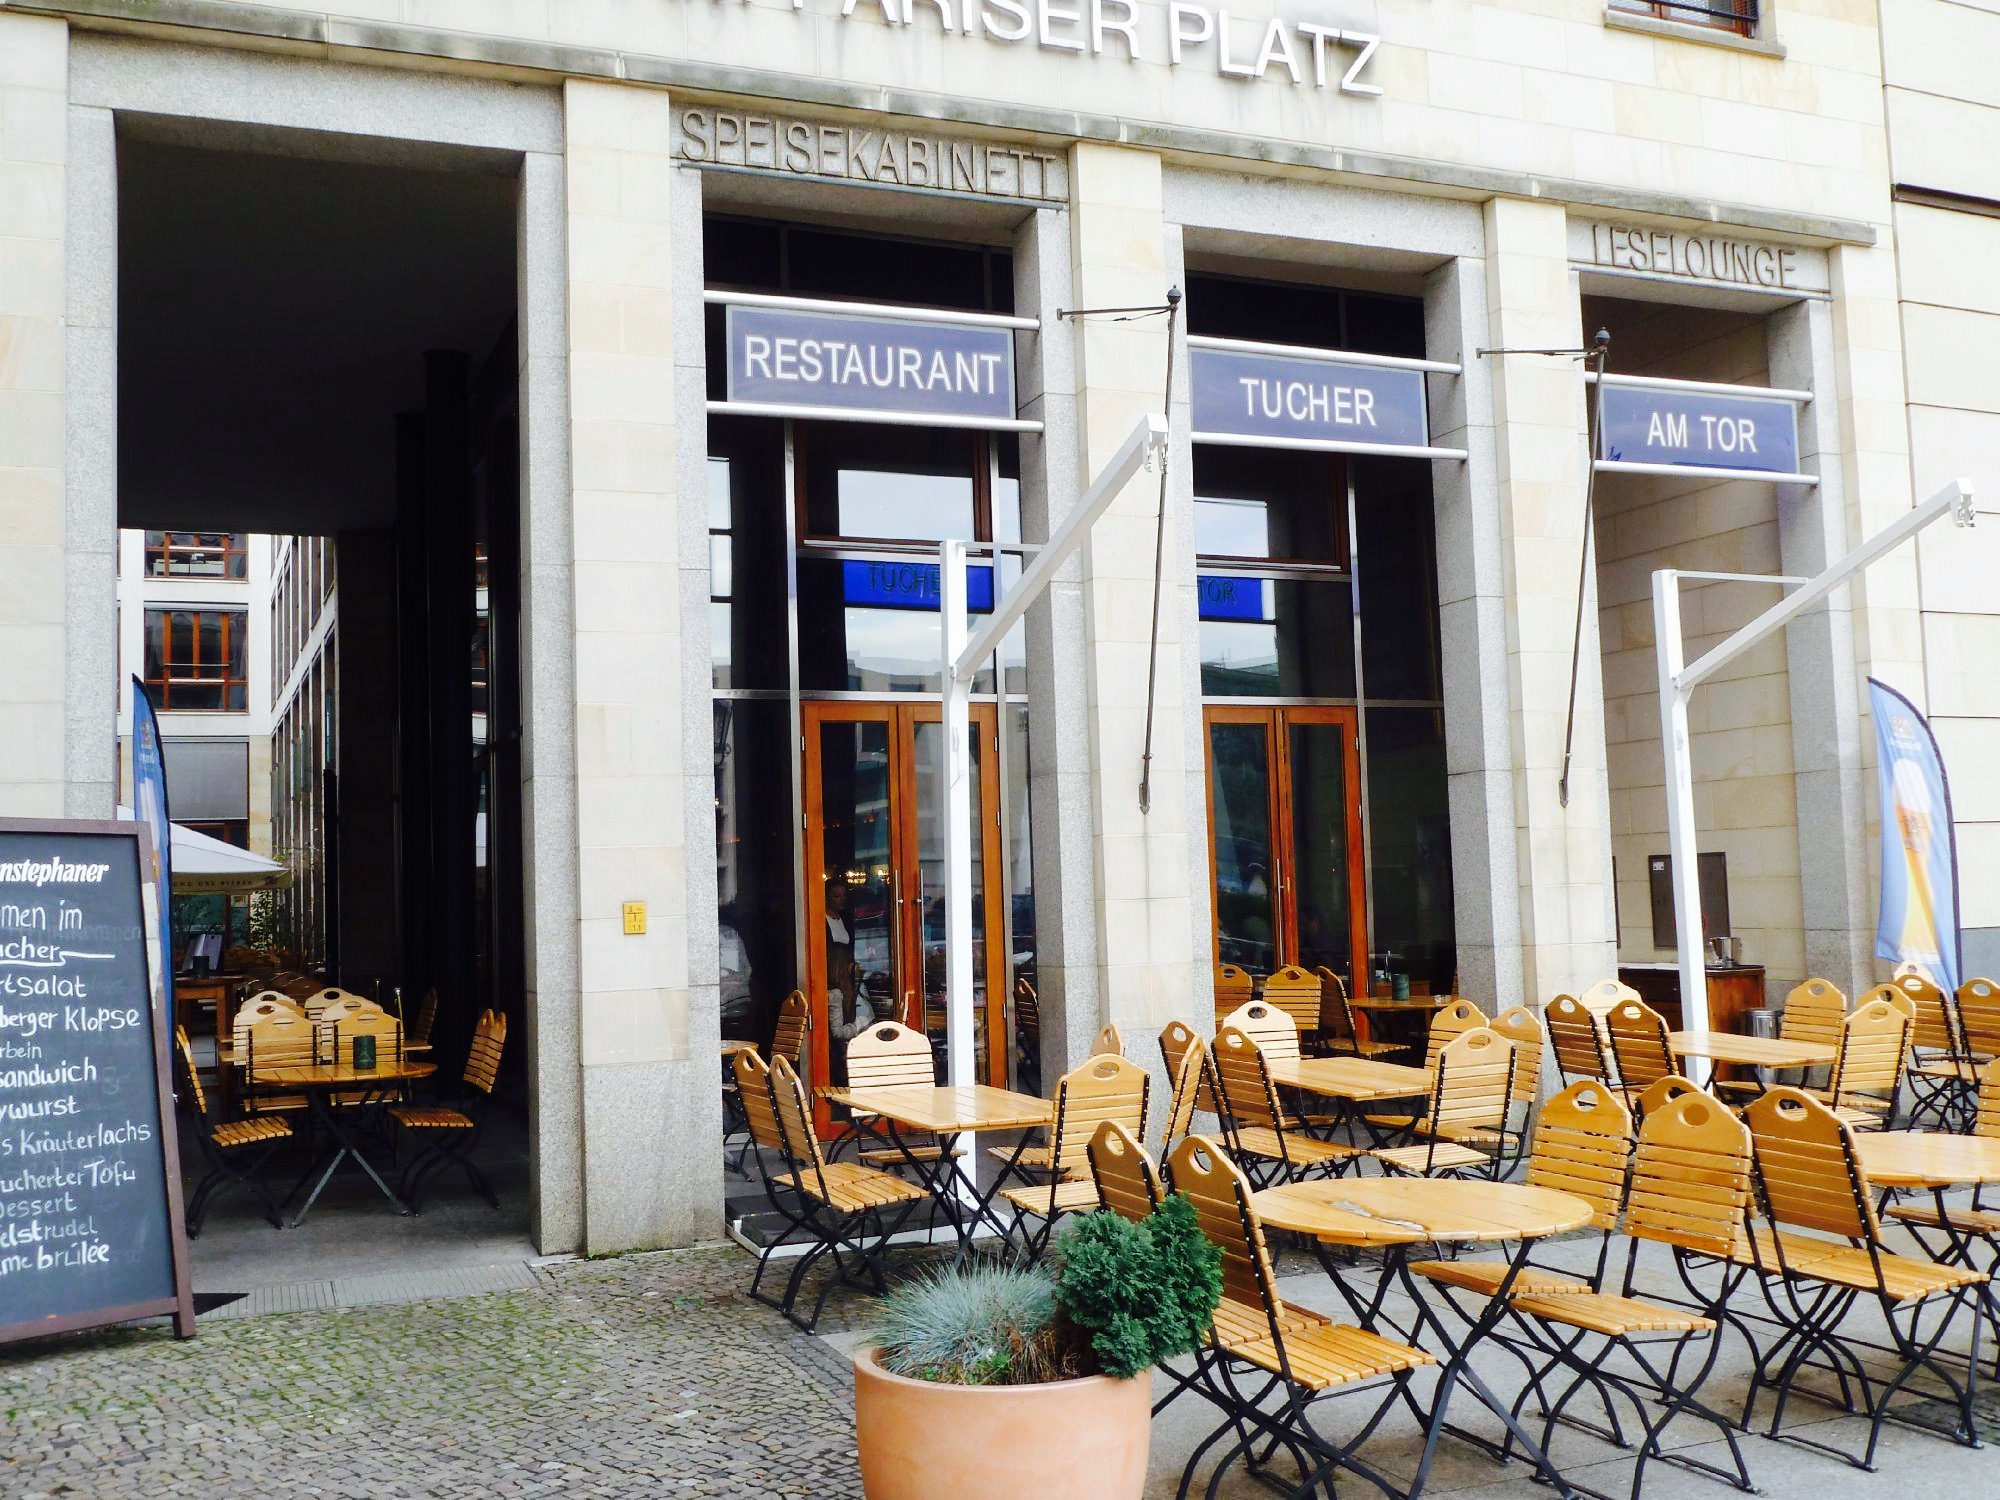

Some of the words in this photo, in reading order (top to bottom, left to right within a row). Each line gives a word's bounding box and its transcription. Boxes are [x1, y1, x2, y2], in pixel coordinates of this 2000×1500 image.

[1168, 1, 1383, 96] PLATZ
[680, 108, 1056, 200] SPEISEKABINETT
[1593, 224, 1798, 290] LESELOUNGE
[745, 335, 1001, 394] RESTAURANT
[1239, 377, 1377, 426] TUCHER
[1647, 411, 1688, 448] AM
[1700, 415, 1758, 453] TOR
[868, 562, 940, 593] TUCHE
[0, 856, 109, 886] nstephaner
[59, 899, 82, 931] im
[65, 1005, 141, 1032] Klopse
[83, 1160, 137, 1187] Tofu
